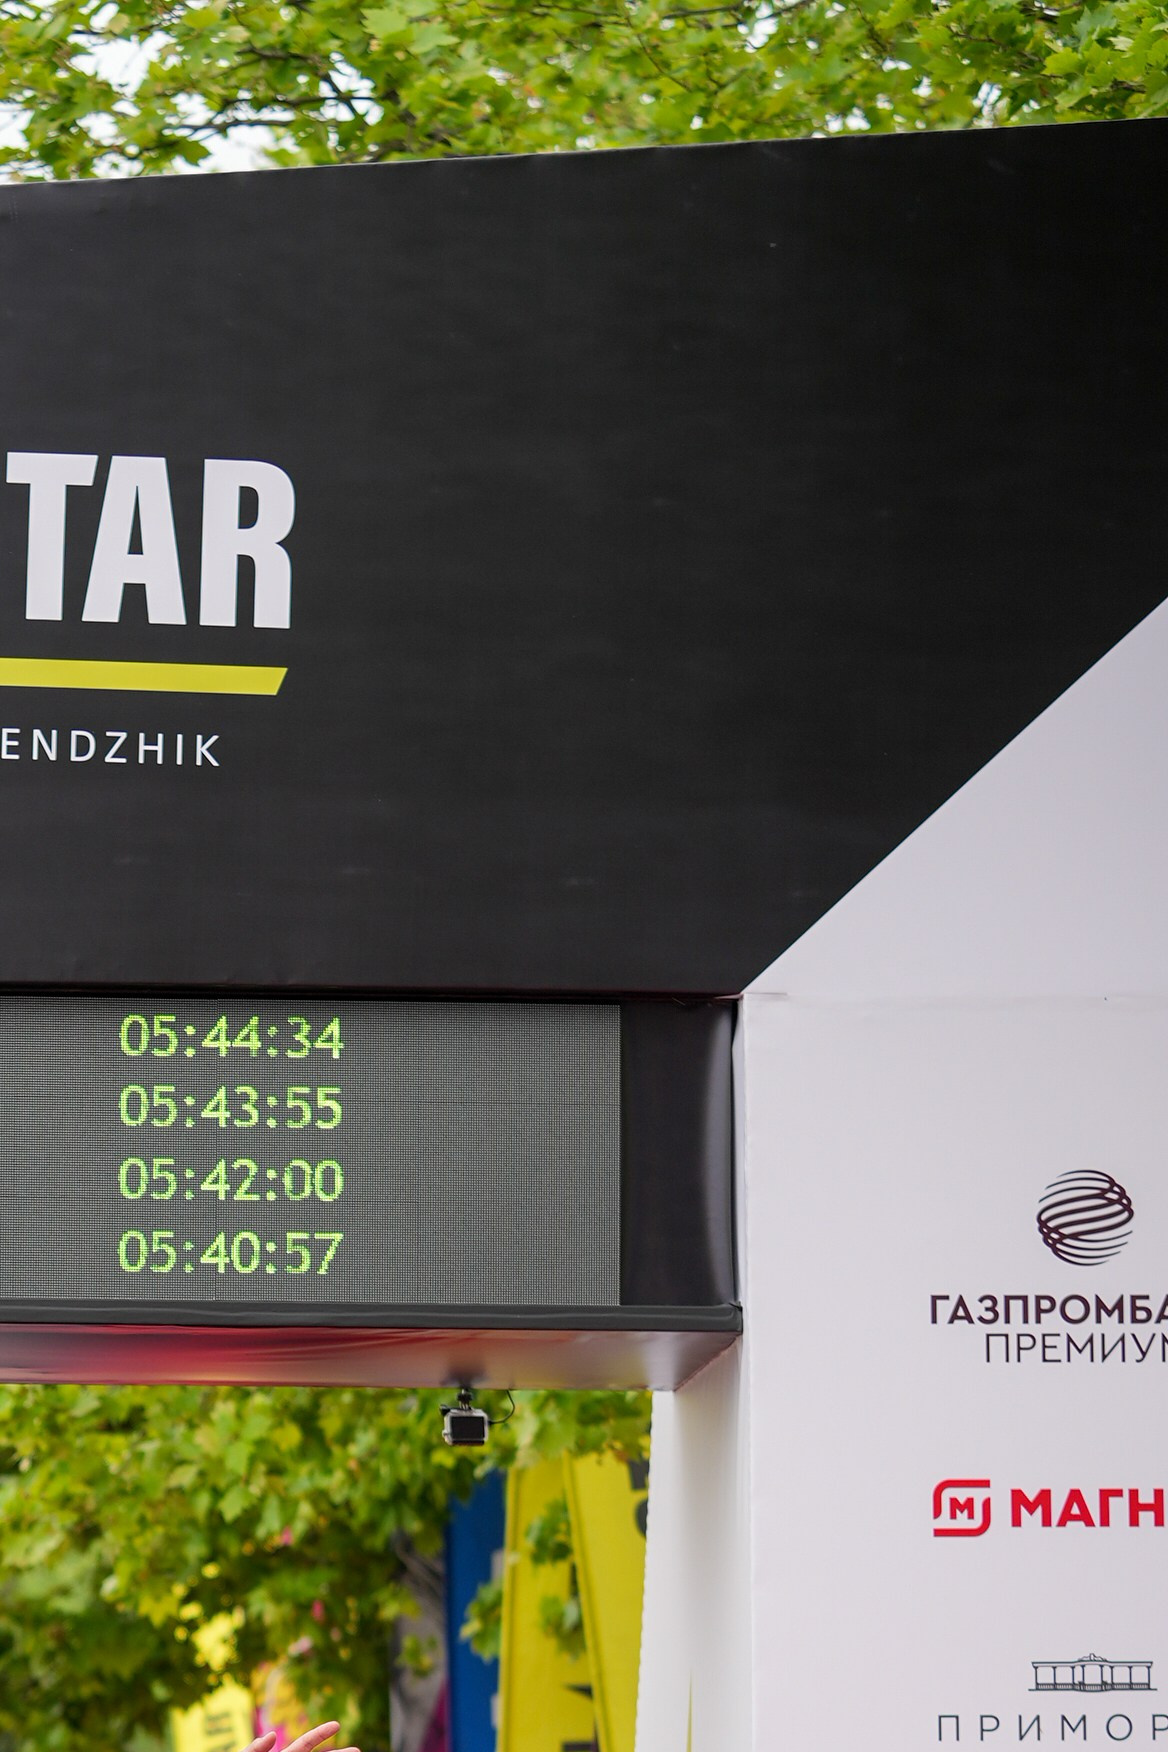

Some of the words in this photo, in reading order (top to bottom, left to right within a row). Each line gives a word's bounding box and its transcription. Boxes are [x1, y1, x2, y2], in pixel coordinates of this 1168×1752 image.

[120, 1014, 344, 1059] 05:44:34
[119, 1084, 343, 1130] 05:43:55
[118, 1157, 344, 1202] 05:42:00
[118, 1230, 344, 1275] 05:40:57
[985, 1332, 1168, 1363] ПРЕМИУ
